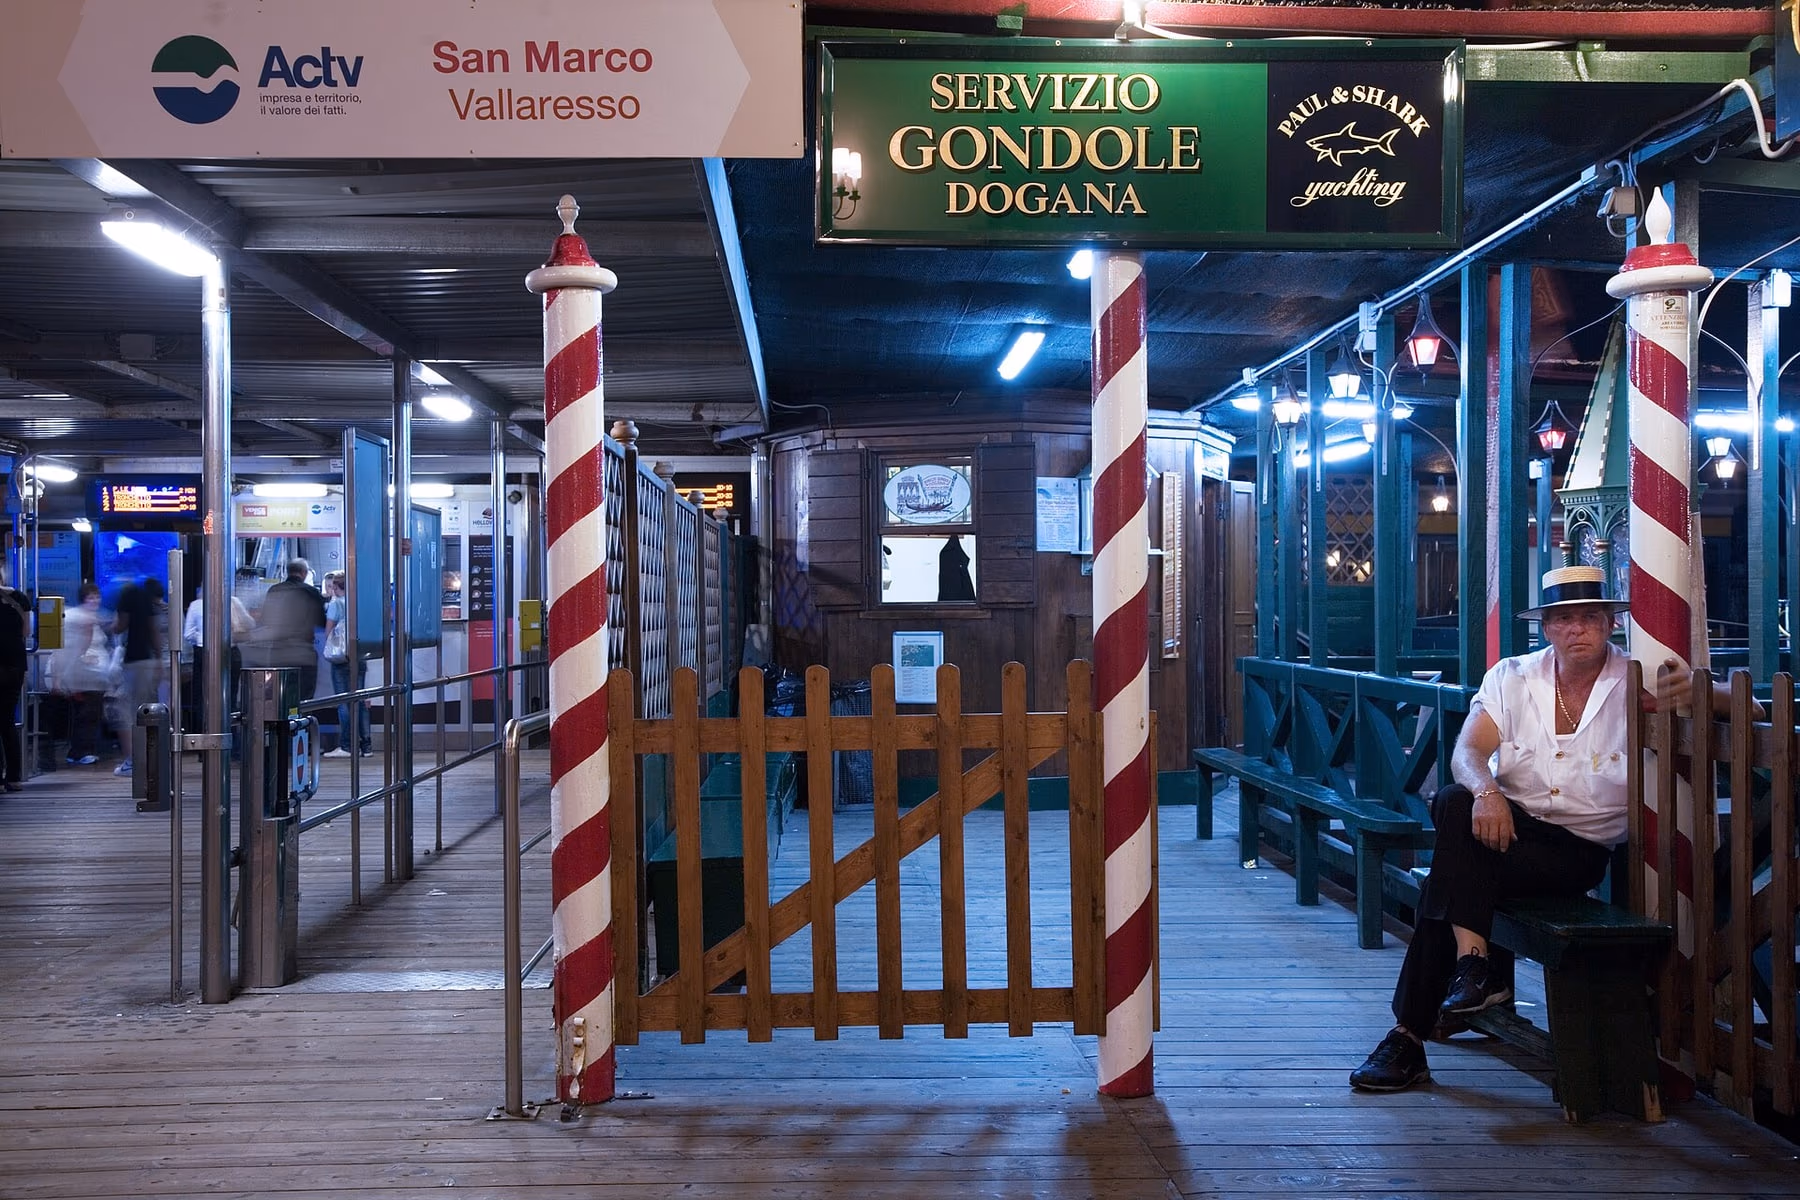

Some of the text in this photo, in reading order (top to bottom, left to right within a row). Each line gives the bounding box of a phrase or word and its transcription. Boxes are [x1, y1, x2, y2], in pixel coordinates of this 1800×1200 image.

[258, 45, 364, 89] Actv
[433, 40, 653, 74] San Marco
[260, 93, 362, 105] impresa e territorio,
[260, 105, 348, 116] il valore dei fatti.
[448, 88, 641, 121] Vallaresso
[930, 73, 1161, 113] SERVIZIO
[1277, 84, 1431, 139] PAUL & SHARK
[889, 125, 1202, 172] GONDOLE
[945, 182, 1148, 215] DOGANA
[1290, 167, 1407, 207] yachting
